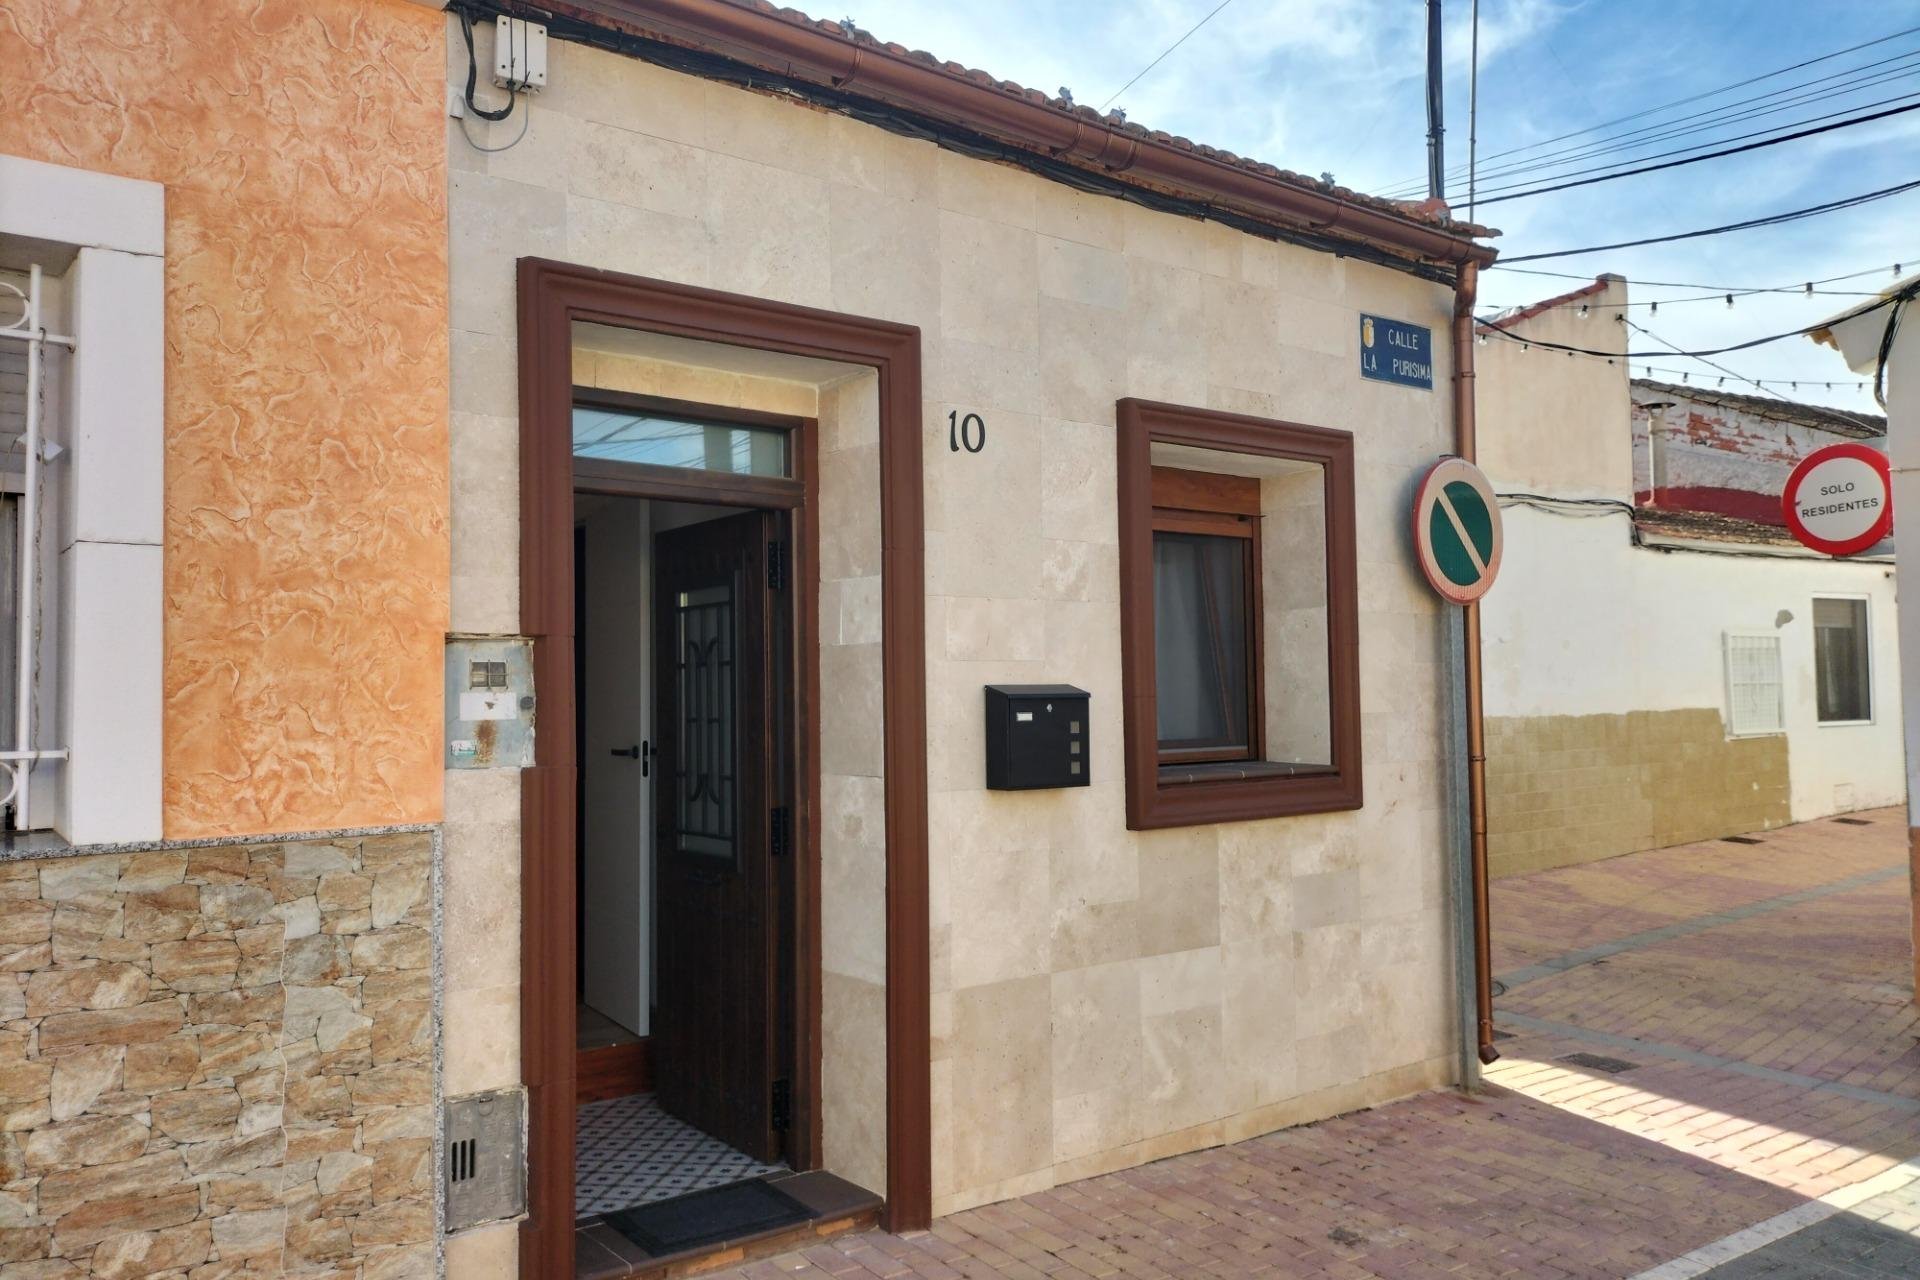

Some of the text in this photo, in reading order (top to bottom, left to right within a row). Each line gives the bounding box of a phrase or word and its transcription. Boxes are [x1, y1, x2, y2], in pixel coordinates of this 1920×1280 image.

[1388, 328, 1419, 350] CALLE
[1363, 353, 1432, 380] LA PURISIMA
[949, 410, 986, 453] 10
[1820, 482, 1855, 496] SOLO
[1801, 498, 1879, 518] RESIDENTES
